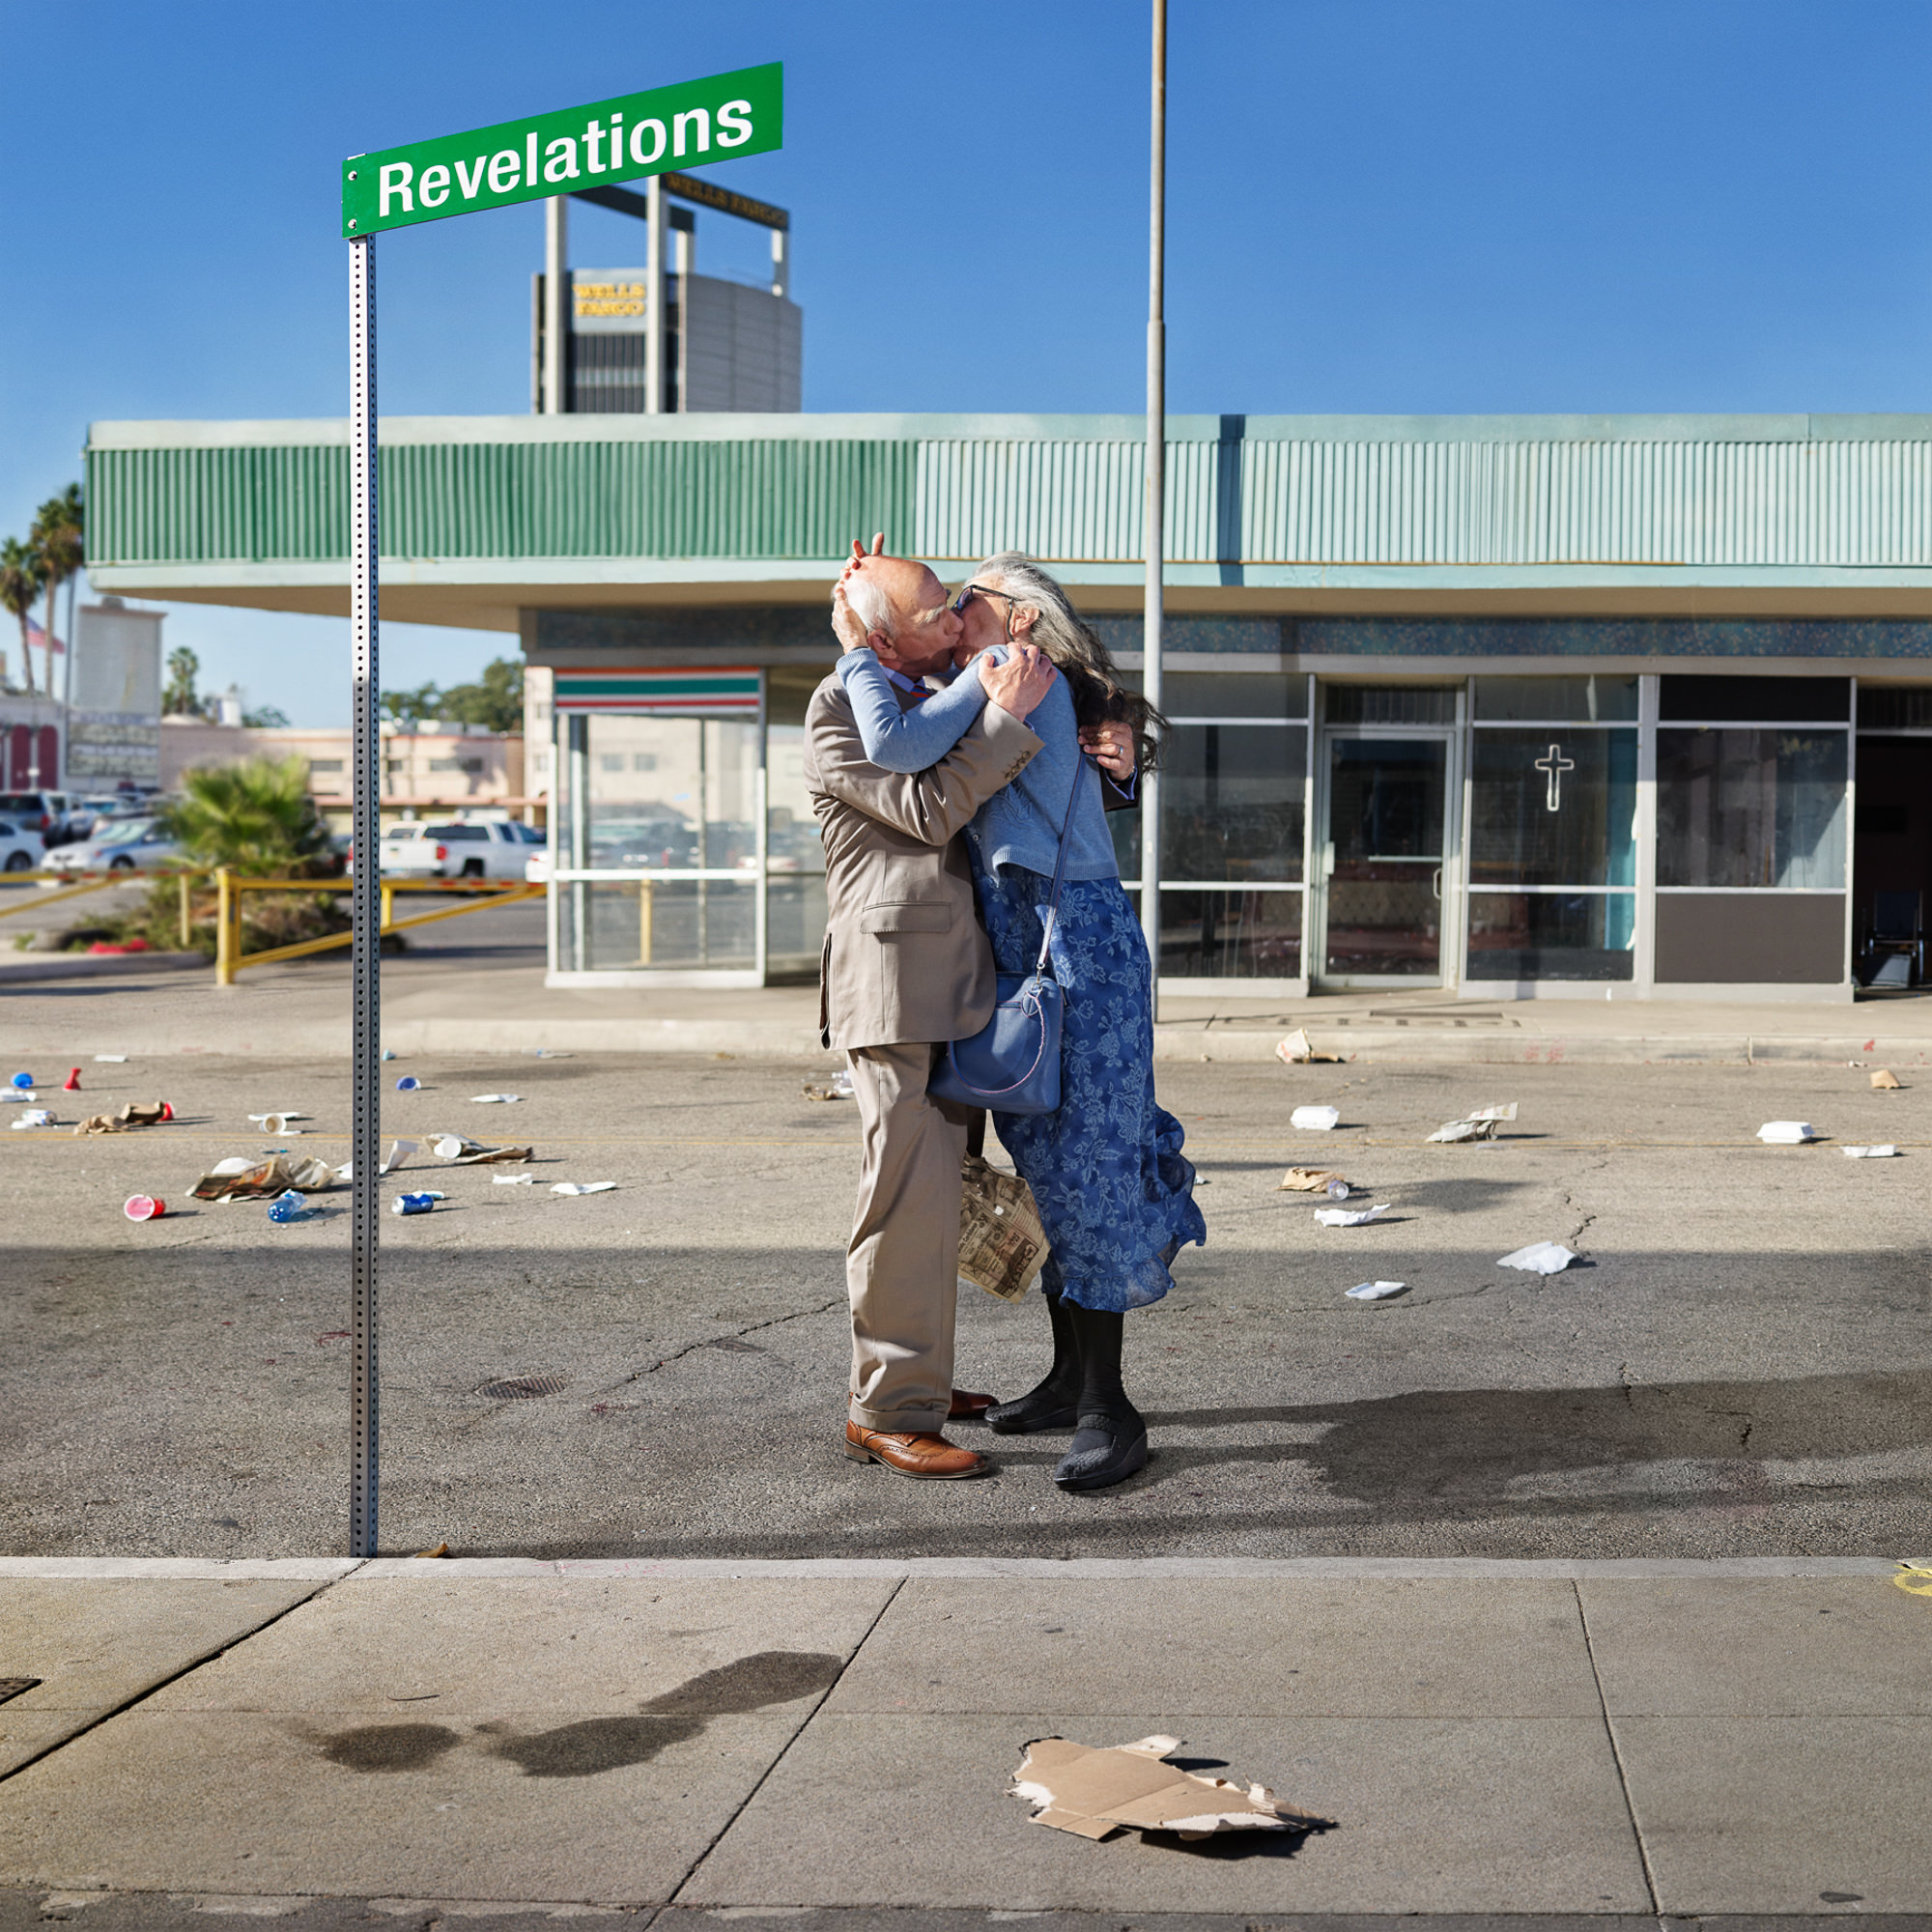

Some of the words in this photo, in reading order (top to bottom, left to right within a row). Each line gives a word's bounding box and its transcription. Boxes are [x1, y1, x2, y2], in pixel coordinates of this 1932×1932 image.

[378, 99, 753, 218] Revelations
[667, 175, 728, 207] WELLS
[573, 283, 645, 299] WELLS
[574, 300, 645, 317] FARGO
